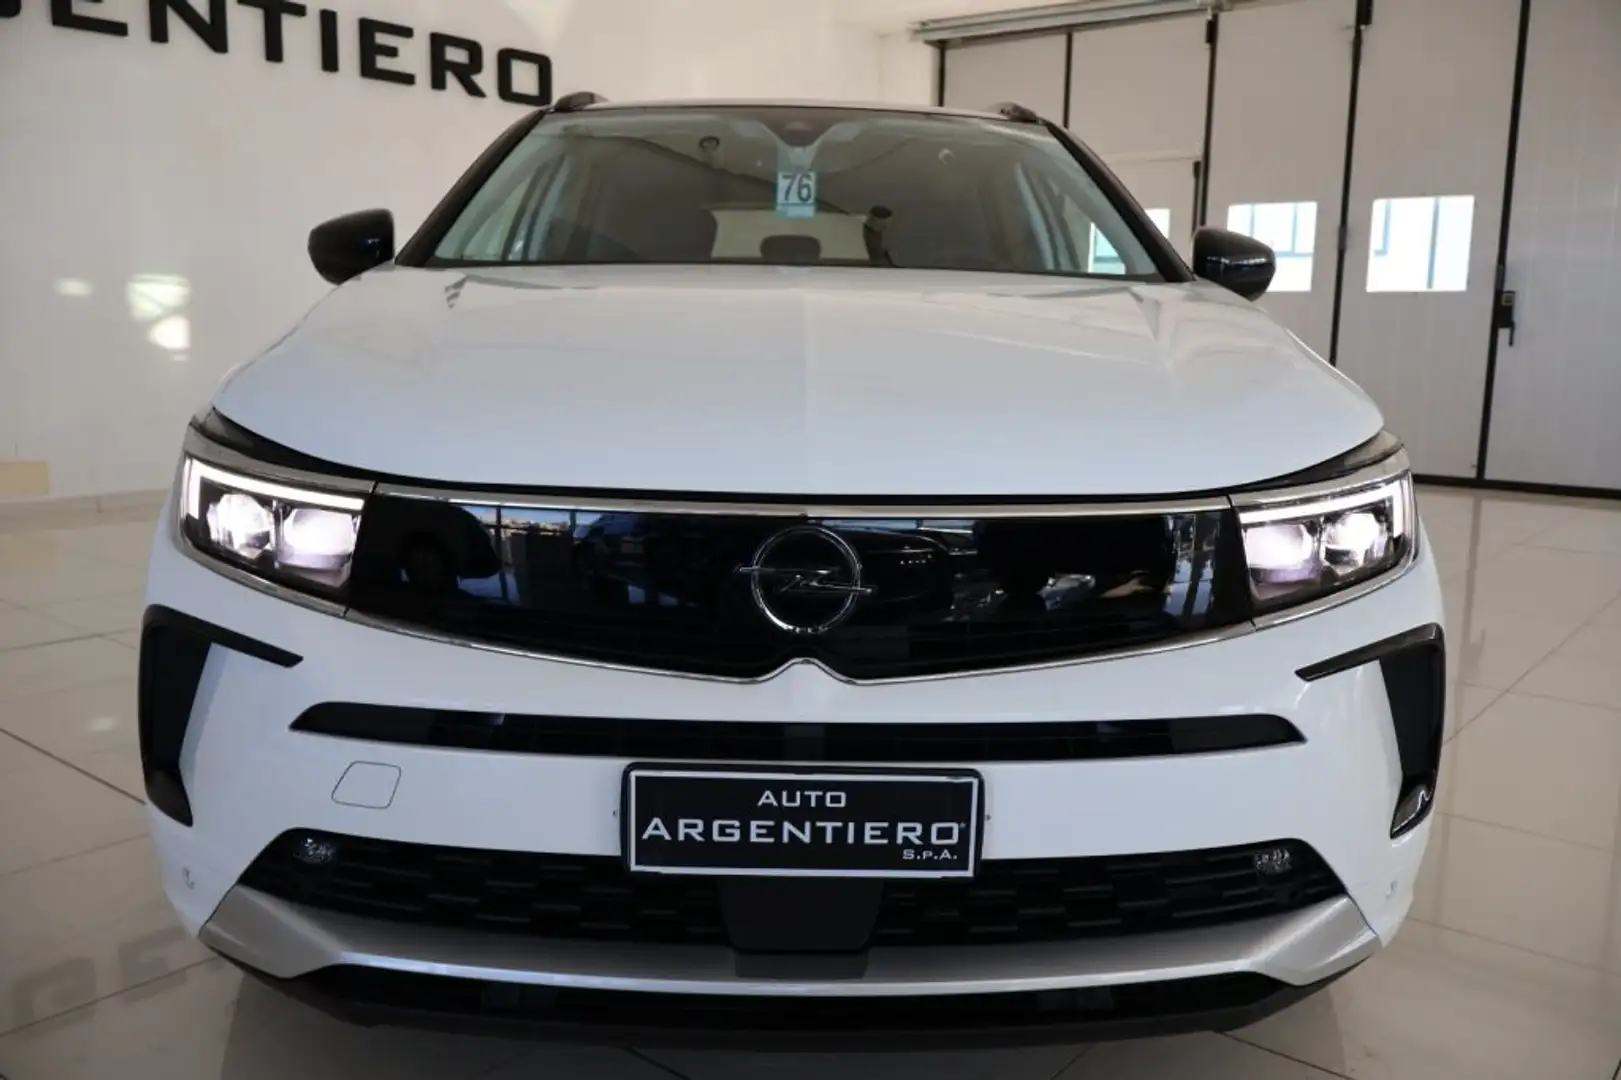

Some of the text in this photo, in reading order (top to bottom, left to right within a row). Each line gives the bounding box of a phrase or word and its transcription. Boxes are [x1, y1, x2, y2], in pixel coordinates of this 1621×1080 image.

[781, 173, 813, 202] 76
[756, 789, 847, 808] AUTO
[641, 817, 960, 846] ARGENTIERO
[902, 848, 958, 860] S.P.A.
